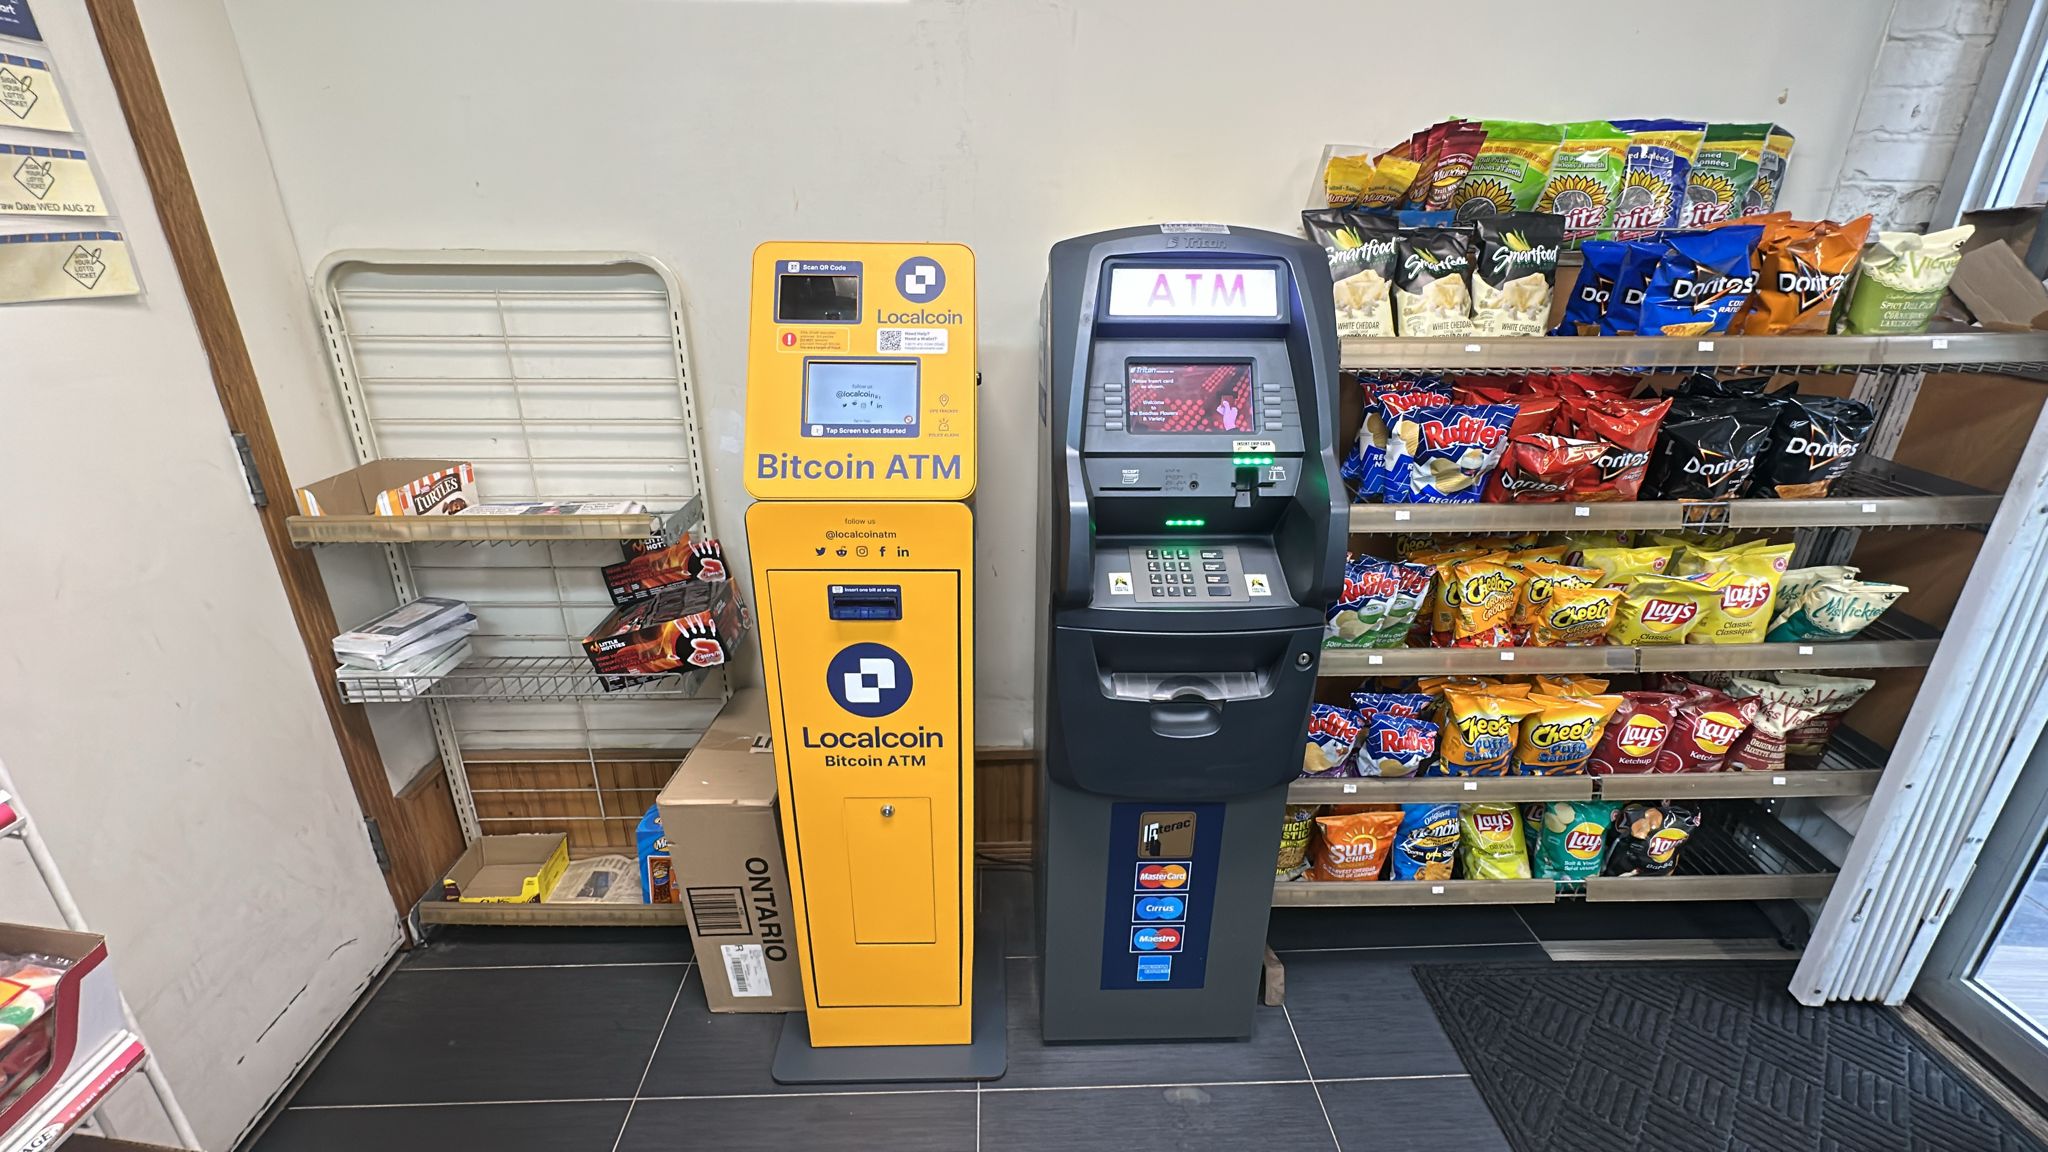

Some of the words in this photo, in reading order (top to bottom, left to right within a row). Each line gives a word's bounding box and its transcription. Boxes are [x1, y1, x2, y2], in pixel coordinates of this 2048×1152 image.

[3, 91, 25, 100] LOTTO
[16, 202, 36, 211] Date
[37, 203, 60, 212] WED
[63, 204, 83, 212] AUG
[1326, 237, 1396, 266] Smartfood
[1492, 245, 1558, 273] Smartfood
[820, 264, 829, 272] QR
[1147, 273, 1247, 307] ATM
[1674, 277, 1753, 299] Doritos
[877, 309, 963, 325] Localcoin
[1337, 322, 1355, 330] WHITE
[1356, 321, 1380, 330] CHEDDAR
[1432, 323, 1450, 331] WHITE
[1501, 323, 1519, 331] WHITE
[1519, 324, 1542, 333] CHEDDAR
[1136, 366, 1156, 374] Triton
[1422, 415, 1509, 451] Ruffles
[1786, 437, 1859, 458] Doritos
[757, 452, 875, 480] Bitcoin
[885, 454, 961, 480] ATM
[1683, 455, 1756, 476] Doritos
[415, 477, 459, 512] TURTLES
[825, 529, 897, 540] @localcoinatm
[1338, 572, 1398, 606] Ruffles
[1466, 572, 1515, 604] Cheetos
[1724, 585, 1770, 609] Lay's
[1643, 600, 1697, 624] Lay's
[1640, 633, 1672, 641] Classic
[1716, 628, 1754, 636] Classique
[599, 639, 618, 647] LITTLE
[802, 726, 944, 749] Localcoin
[1620, 725, 1665, 748] Lay's
[824, 755, 883, 767] Bitcoin
[887, 755, 926, 766] ATM
[1619, 757, 1652, 765] Ketchup
[1424, 809, 1450, 826] Original
[1476, 813, 1511, 832] Lay's
[1144, 819, 1191, 842] Interac
[1329, 841, 1377, 865] Sun
[1345, 855, 1374, 863] CHIPS
[1139, 872, 1186, 881] MasterCard
[745, 857, 788, 962] ONTARIO
[1145, 904, 1174, 912] Cirrus
[1139, 935, 1176, 943] Maestro
